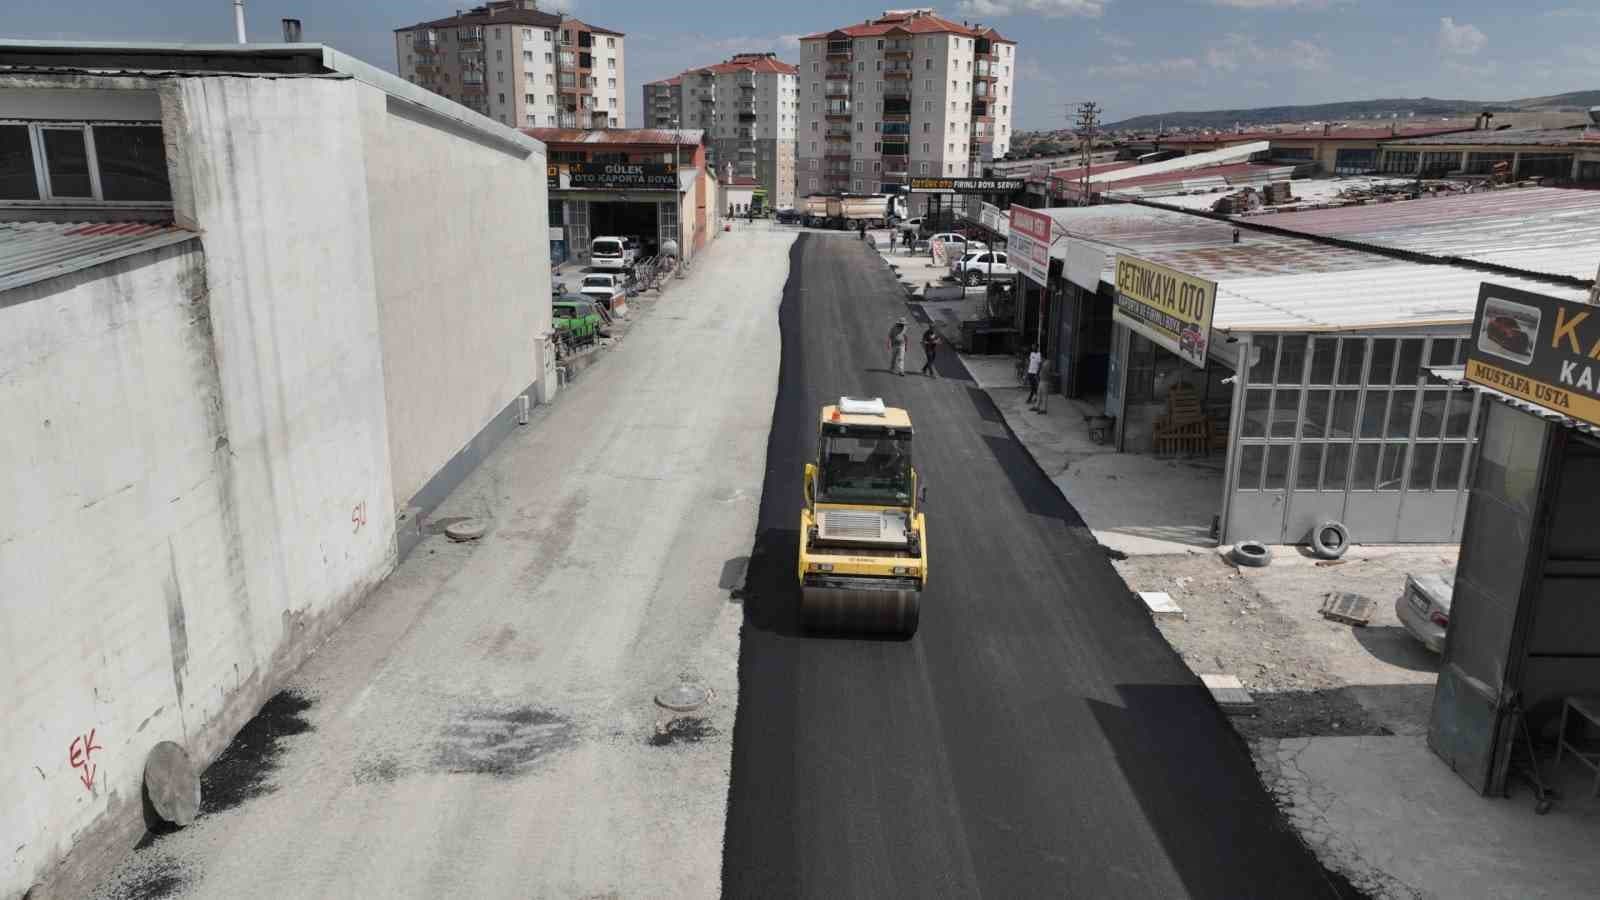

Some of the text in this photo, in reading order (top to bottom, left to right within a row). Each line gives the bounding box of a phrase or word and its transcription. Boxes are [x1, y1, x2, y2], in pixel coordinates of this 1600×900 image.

[1179, 281, 1205, 321] OTO
[1551, 306, 1600, 360] K
[1475, 363, 1569, 408] MUSTAFA USTA
[1560, 360, 1600, 394] KA
[70, 728, 102, 768] EK
